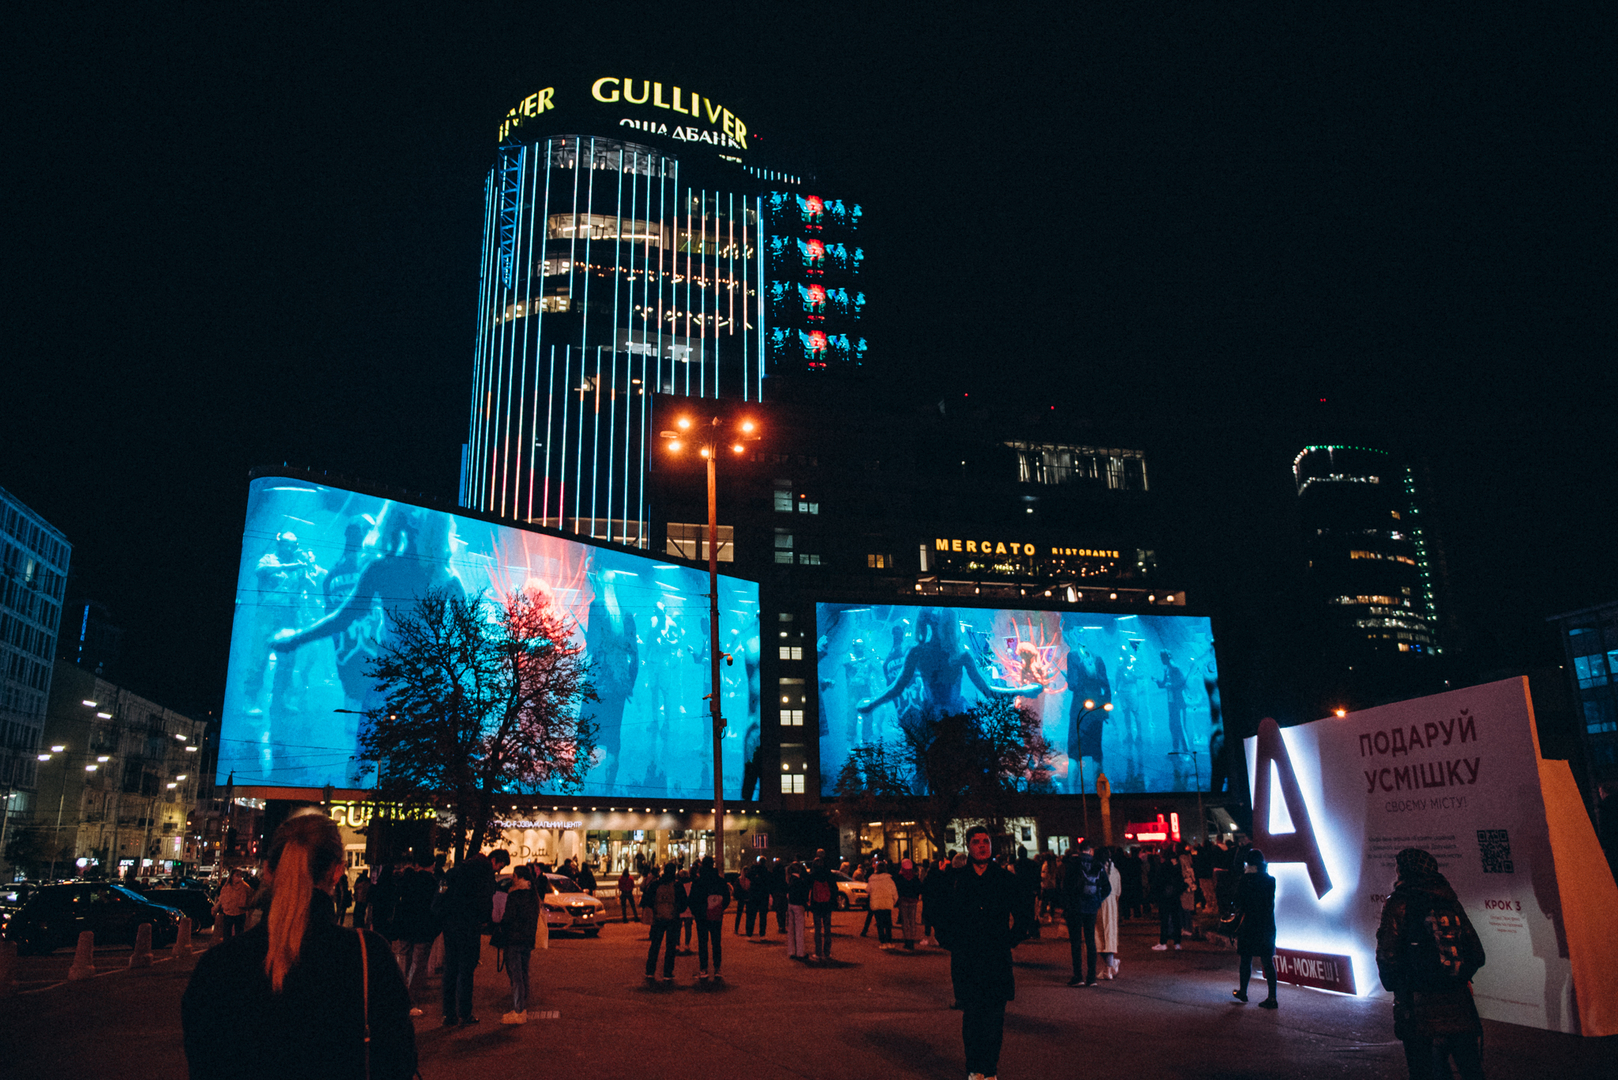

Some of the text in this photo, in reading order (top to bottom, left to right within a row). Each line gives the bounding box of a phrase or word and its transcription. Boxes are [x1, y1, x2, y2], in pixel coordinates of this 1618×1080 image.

[591, 77, 748, 150] GULLIVER
[935, 538, 1120, 559] MERCATO RISTORANTE
[1359, 708, 1477, 758] ПОДАРУЙ
[1364, 757, 1481, 794] УСМІШКУ
[1385, 796, 1468, 813] СВОЄМУ МІСТУ!
[1484, 899, 1522, 911] КРОК 3
